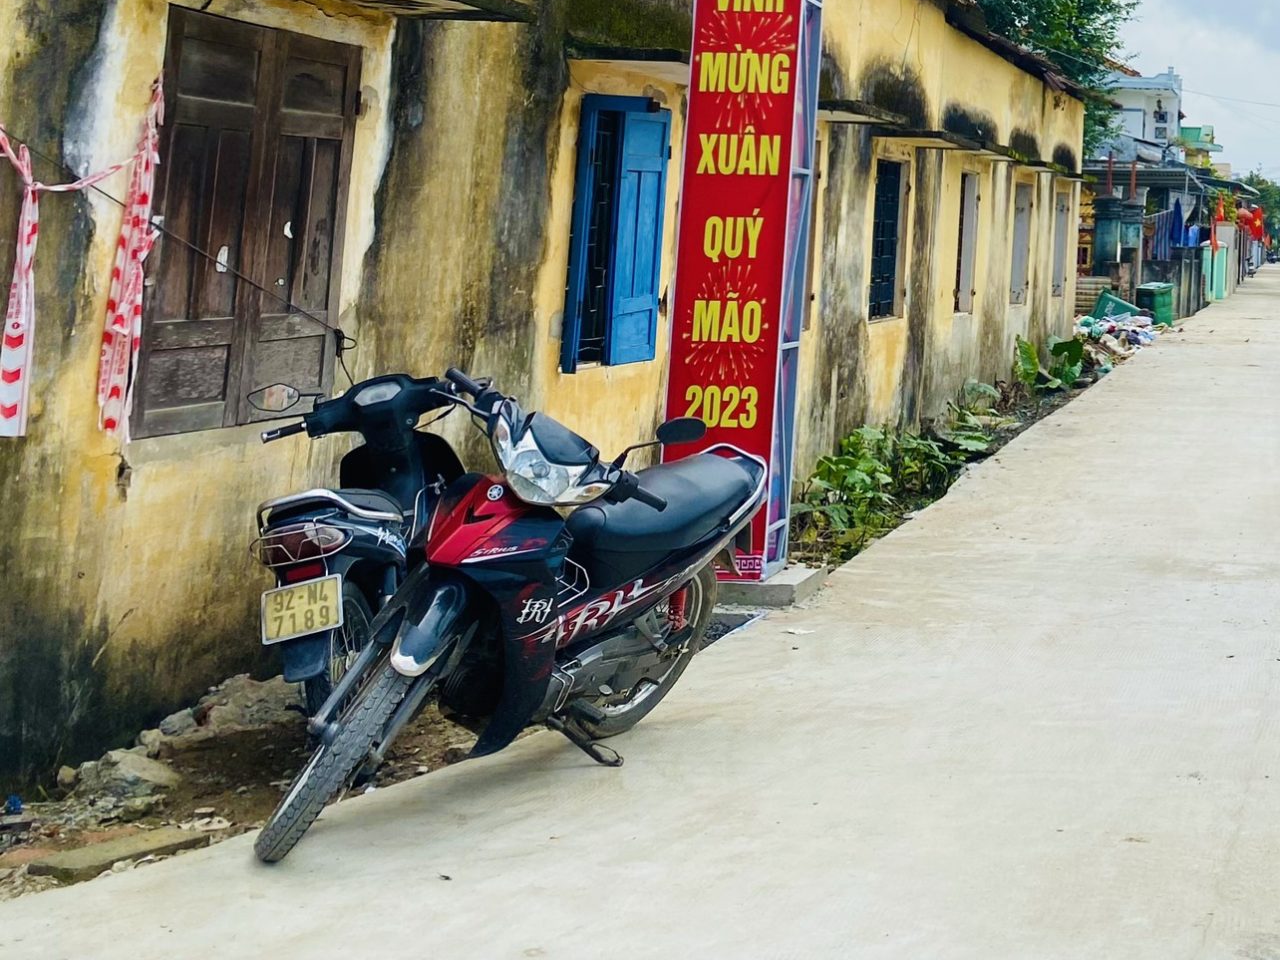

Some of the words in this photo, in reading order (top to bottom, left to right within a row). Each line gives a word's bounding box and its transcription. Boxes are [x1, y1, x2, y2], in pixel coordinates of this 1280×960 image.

[698, 43, 790, 95] MỪNG
[697, 126, 781, 177] XUÂN
[703, 208, 764, 260] QUÝ
[691, 292, 763, 344] MÃO
[684, 384, 758, 430] 2023
[273, 581, 329, 613] 92-N4
[273, 605, 330, 638] 7189
